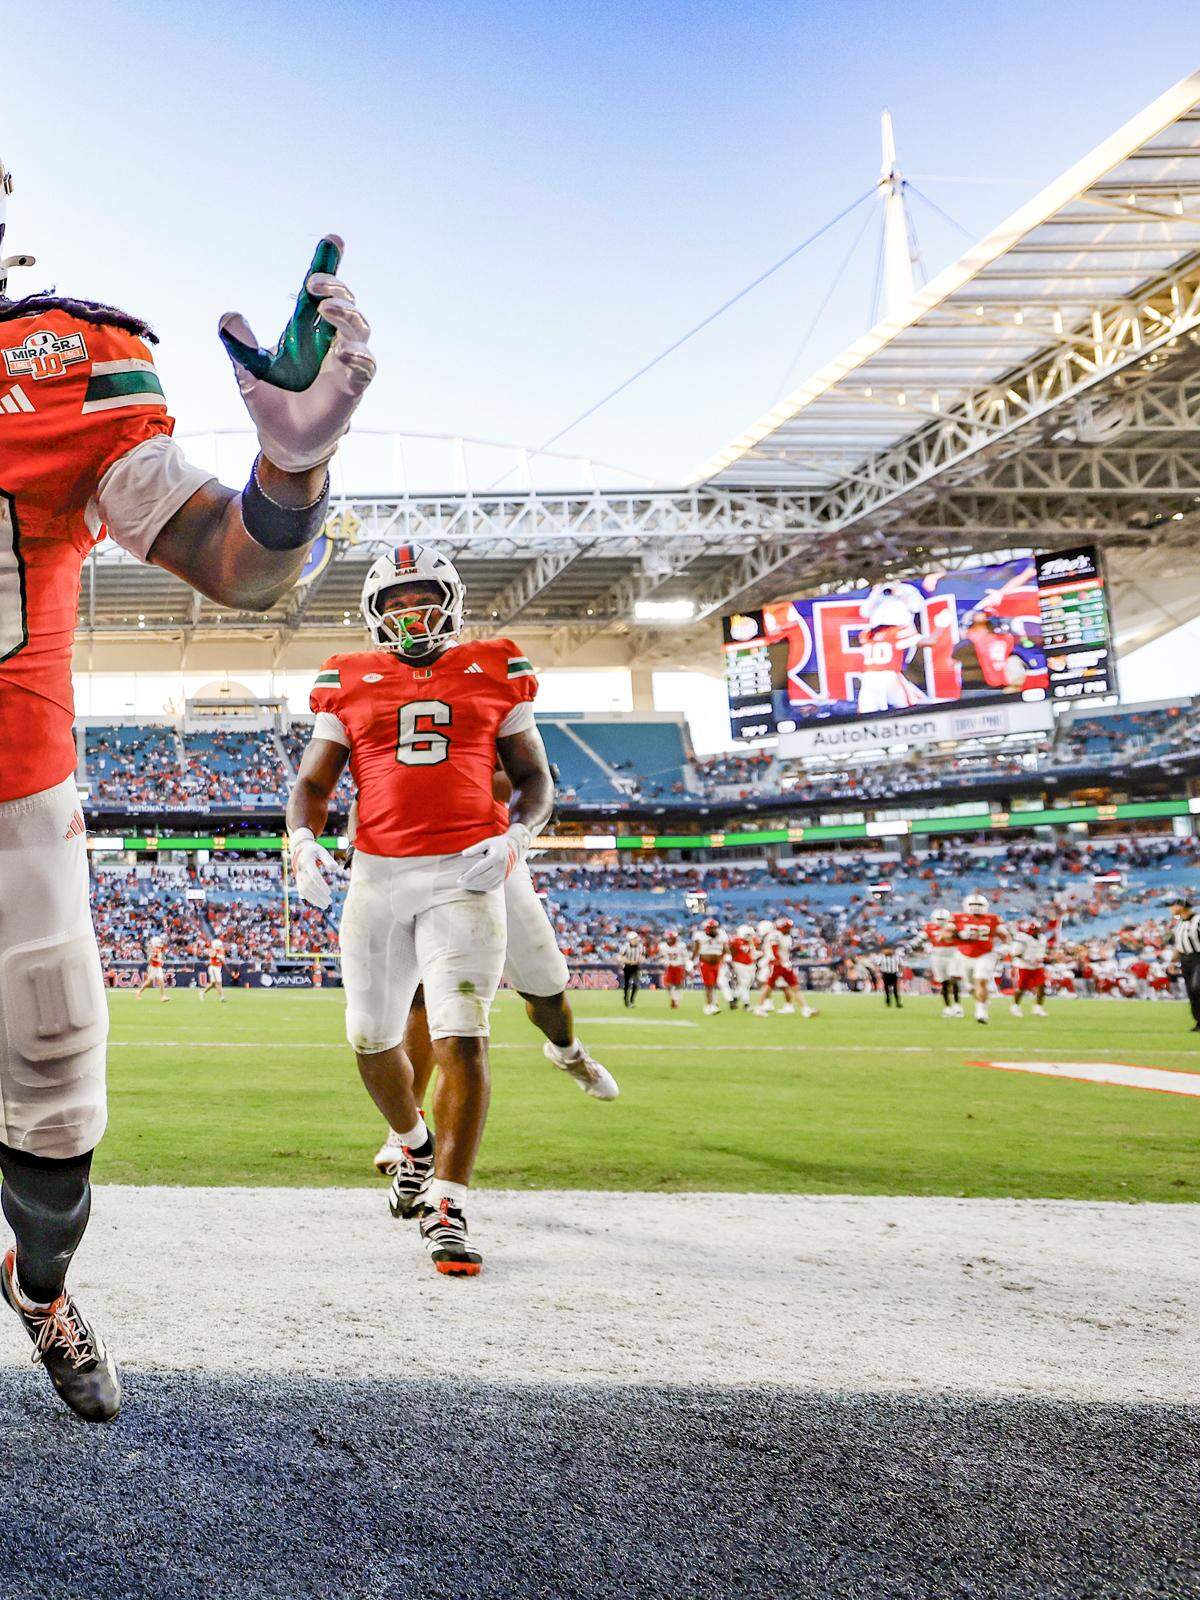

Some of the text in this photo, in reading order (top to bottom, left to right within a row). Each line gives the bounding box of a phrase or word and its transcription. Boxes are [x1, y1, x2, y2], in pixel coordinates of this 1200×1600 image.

[12, 347, 48, 360] MIRA
[51, 340, 75, 352] SR.
[31, 352, 63, 377] 10
[395, 700, 452, 766] 6
[814, 721, 936, 747] AutoNation
[127, 804, 211, 813] NATIONAL CHAMPIONS
